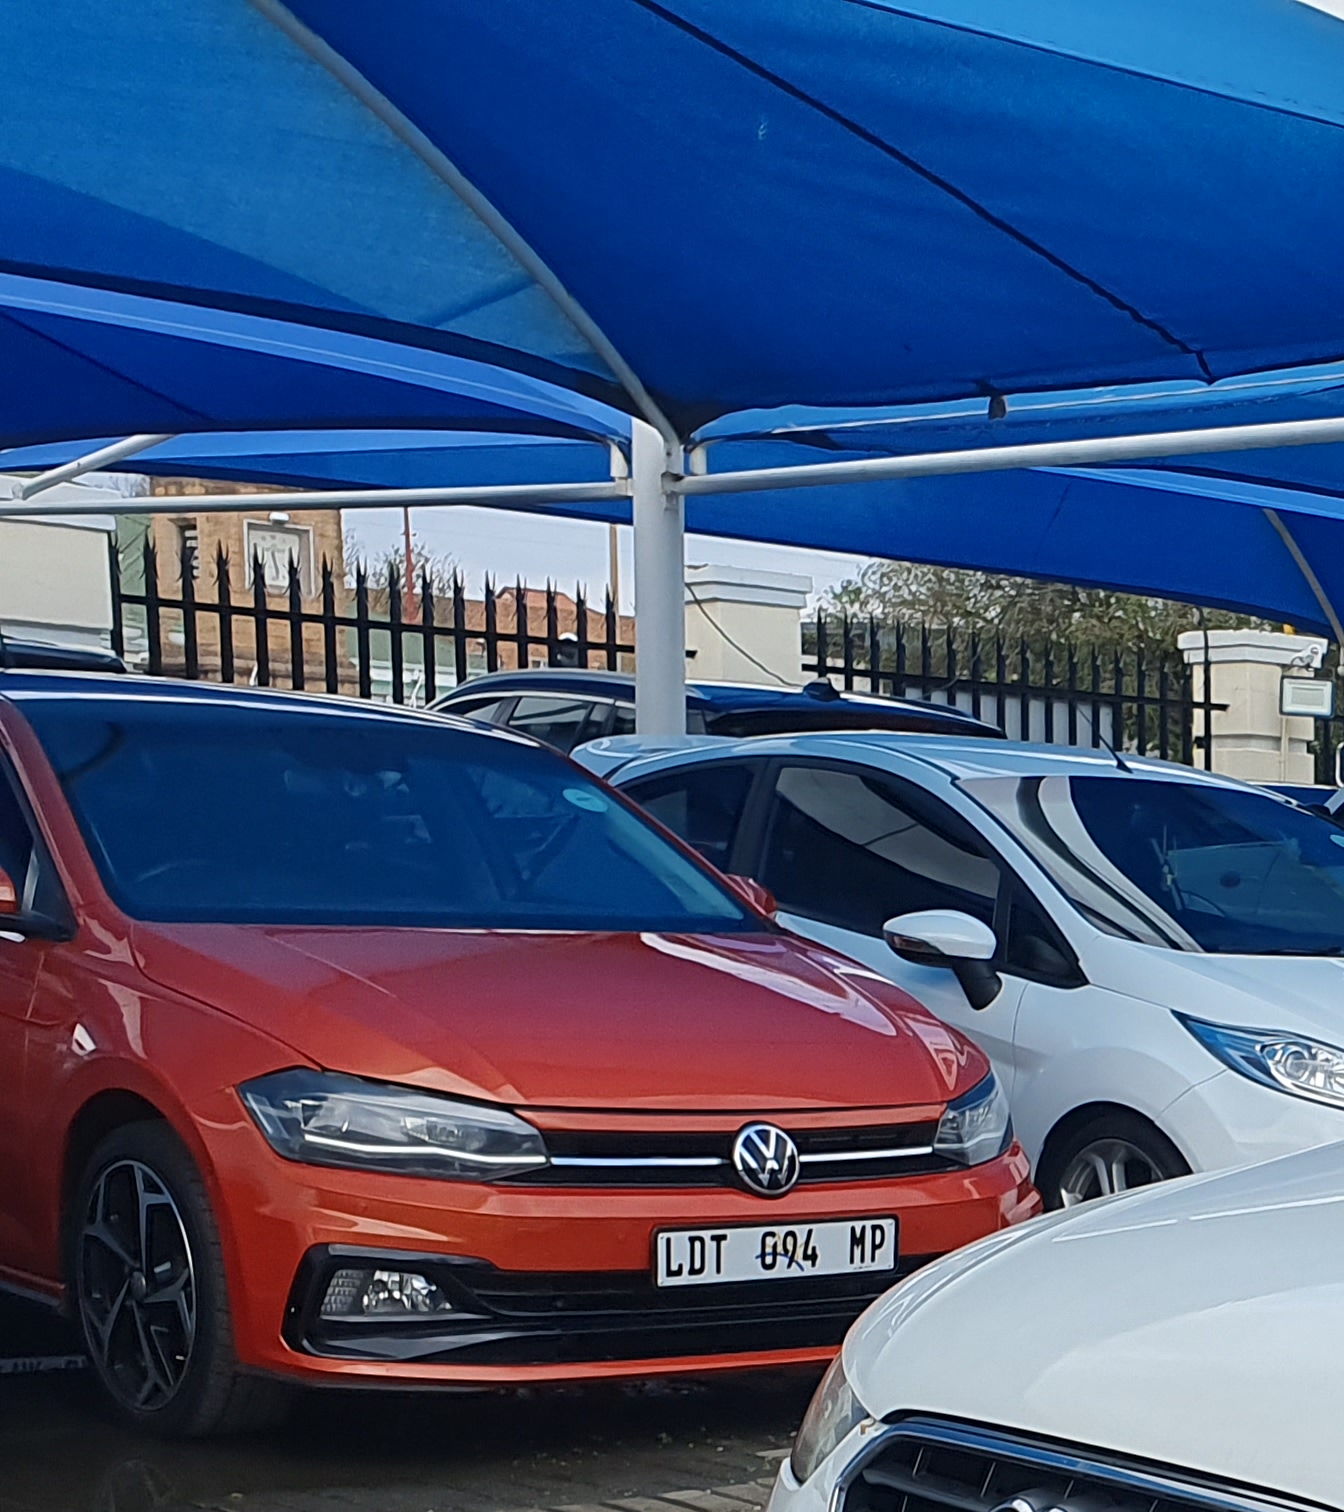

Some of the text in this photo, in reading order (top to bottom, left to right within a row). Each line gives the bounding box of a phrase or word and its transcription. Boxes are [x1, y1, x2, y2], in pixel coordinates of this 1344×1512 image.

[665, 1223, 886, 1277] LDT 094 MP
